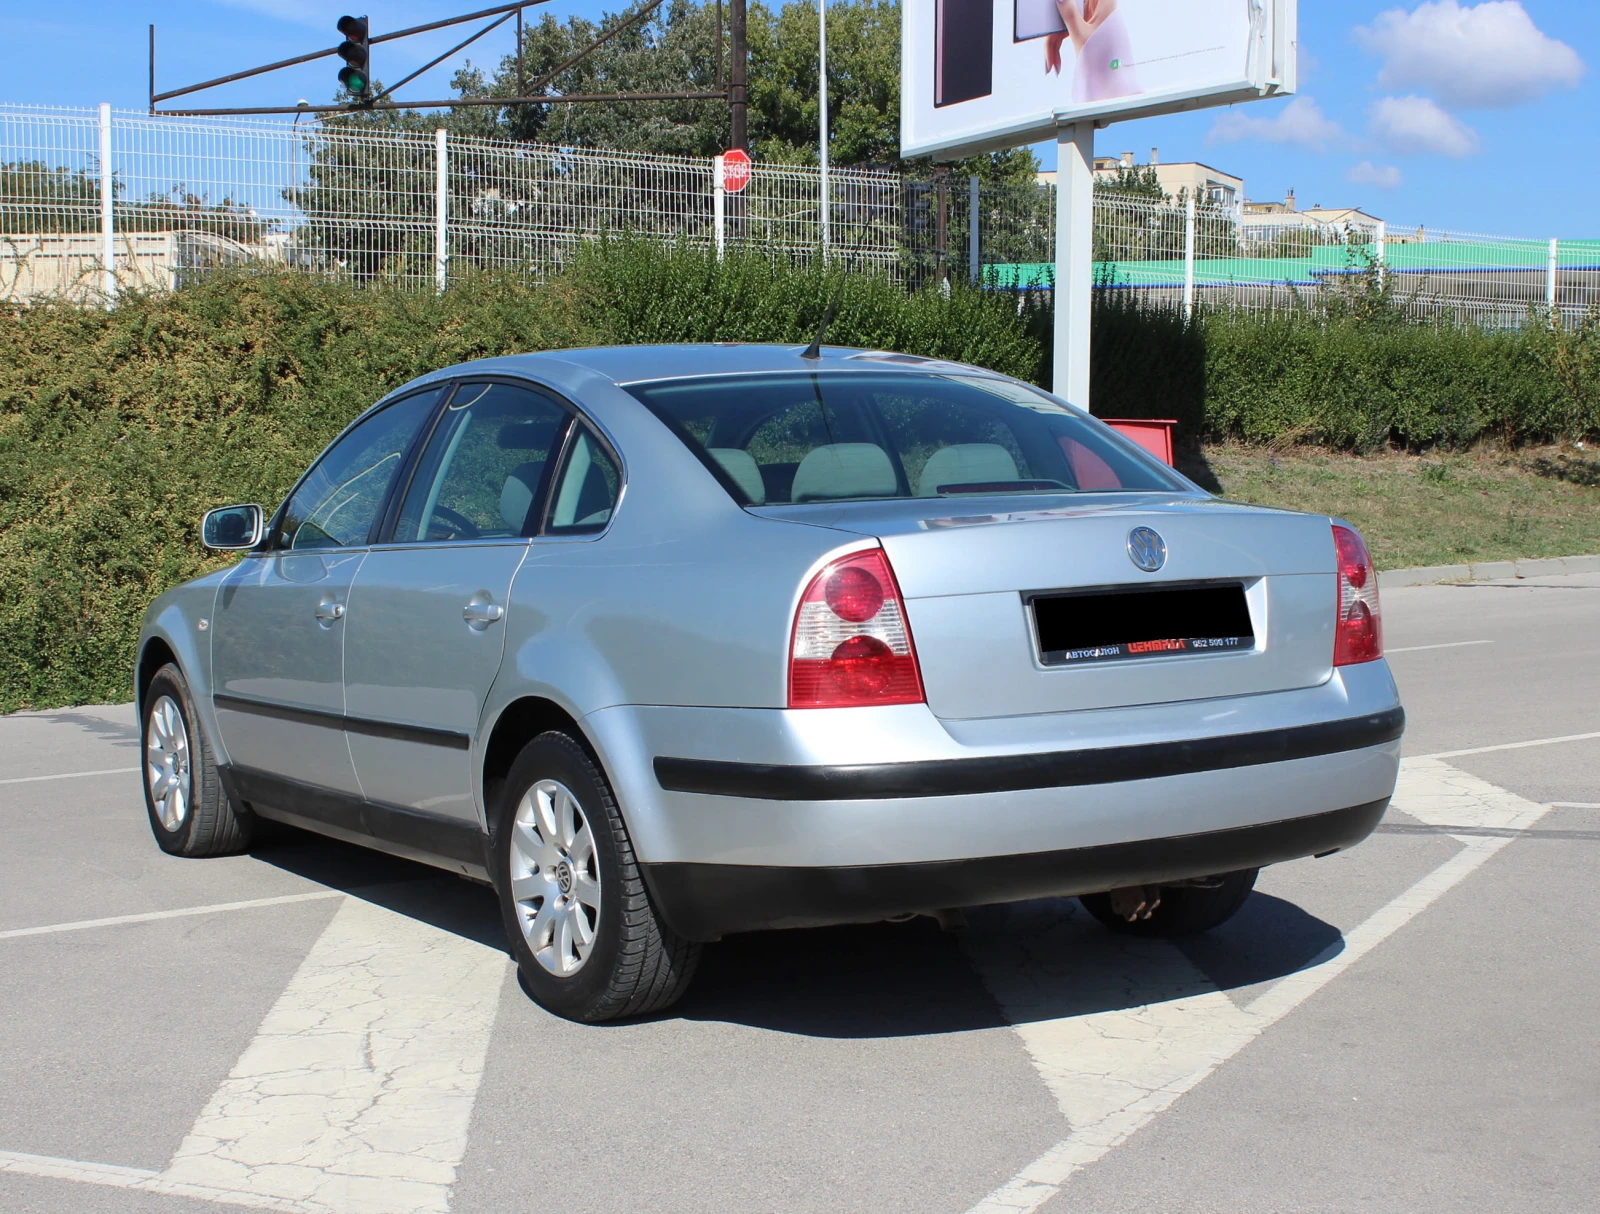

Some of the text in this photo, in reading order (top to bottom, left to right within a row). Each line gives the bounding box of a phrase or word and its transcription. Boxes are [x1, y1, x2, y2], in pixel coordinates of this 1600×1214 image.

[723, 164, 747, 179] STOP
[1066, 647, 1119, 659] АВТОСАЛОН
[1225, 637, 1238, 645] 177
